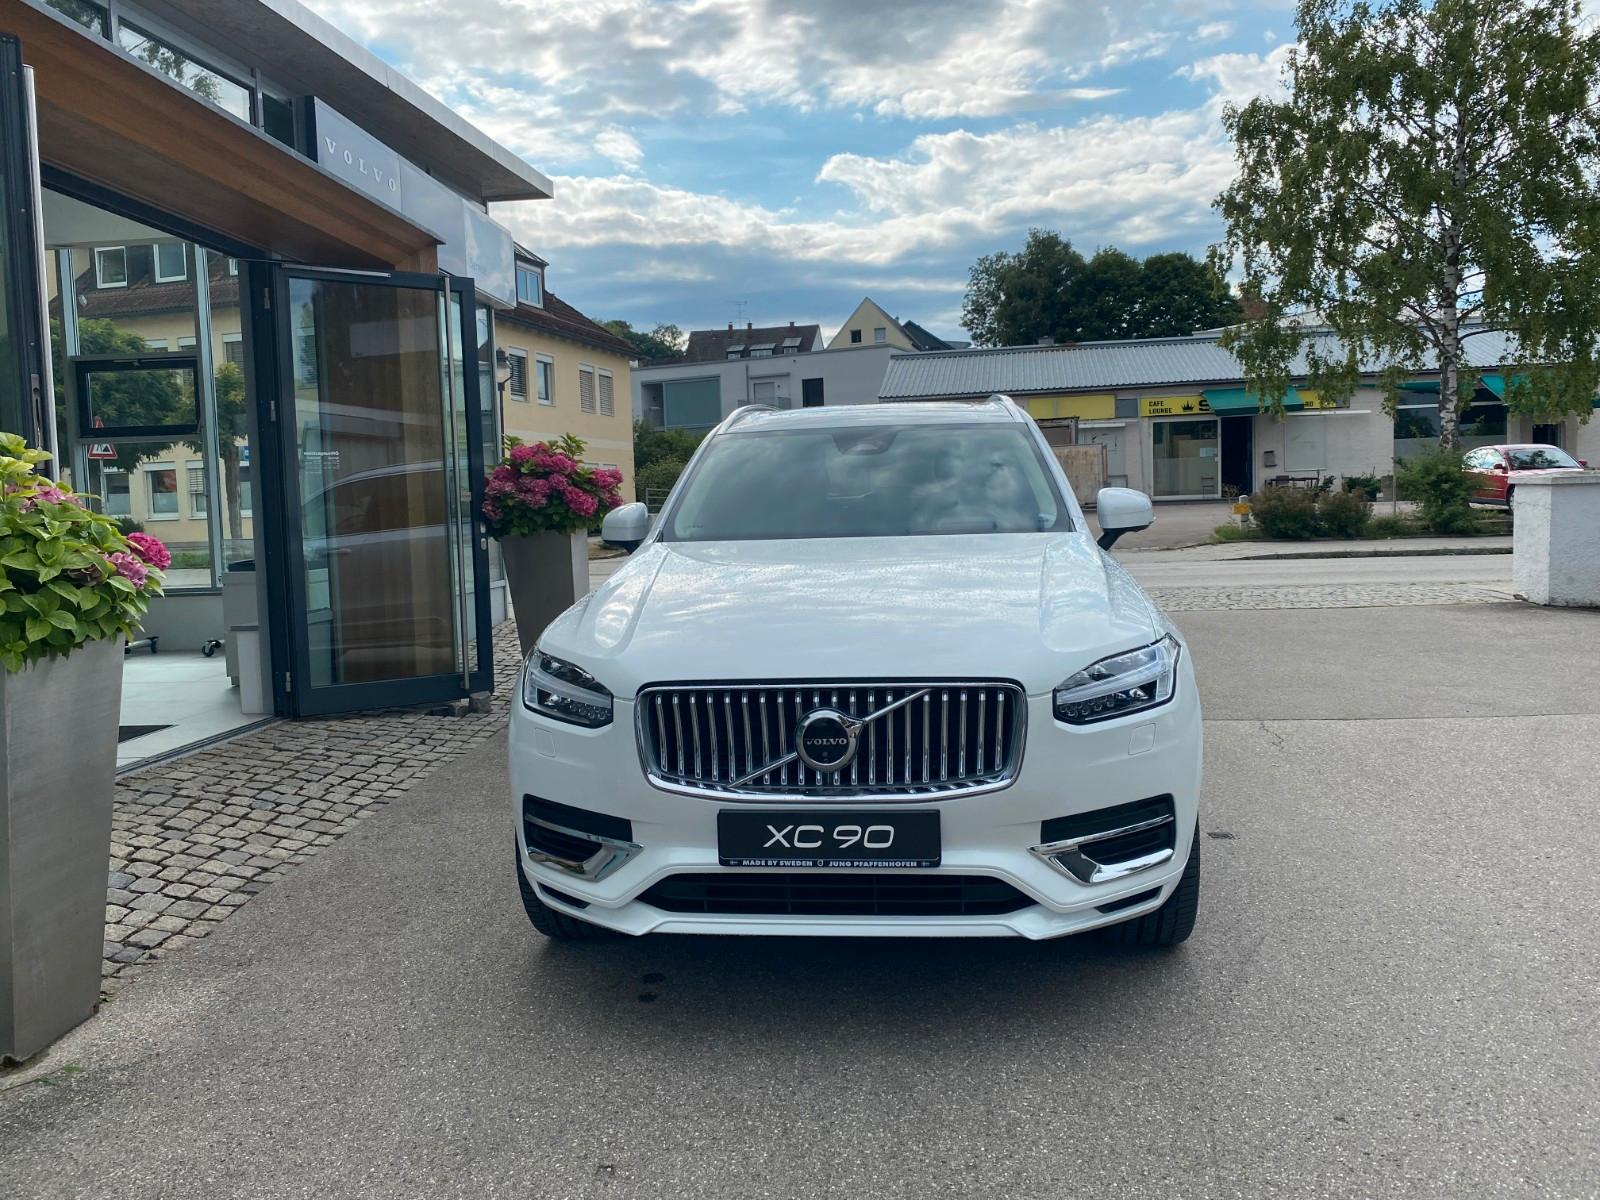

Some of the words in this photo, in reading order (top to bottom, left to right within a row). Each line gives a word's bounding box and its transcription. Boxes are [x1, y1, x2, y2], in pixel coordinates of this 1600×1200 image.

[323, 135, 397, 192] VOLVO
[1148, 407, 1173, 415] LOUNGE
[806, 737, 848, 745] VOLVO
[763, 824, 825, 849] XC
[832, 824, 895, 849] 90
